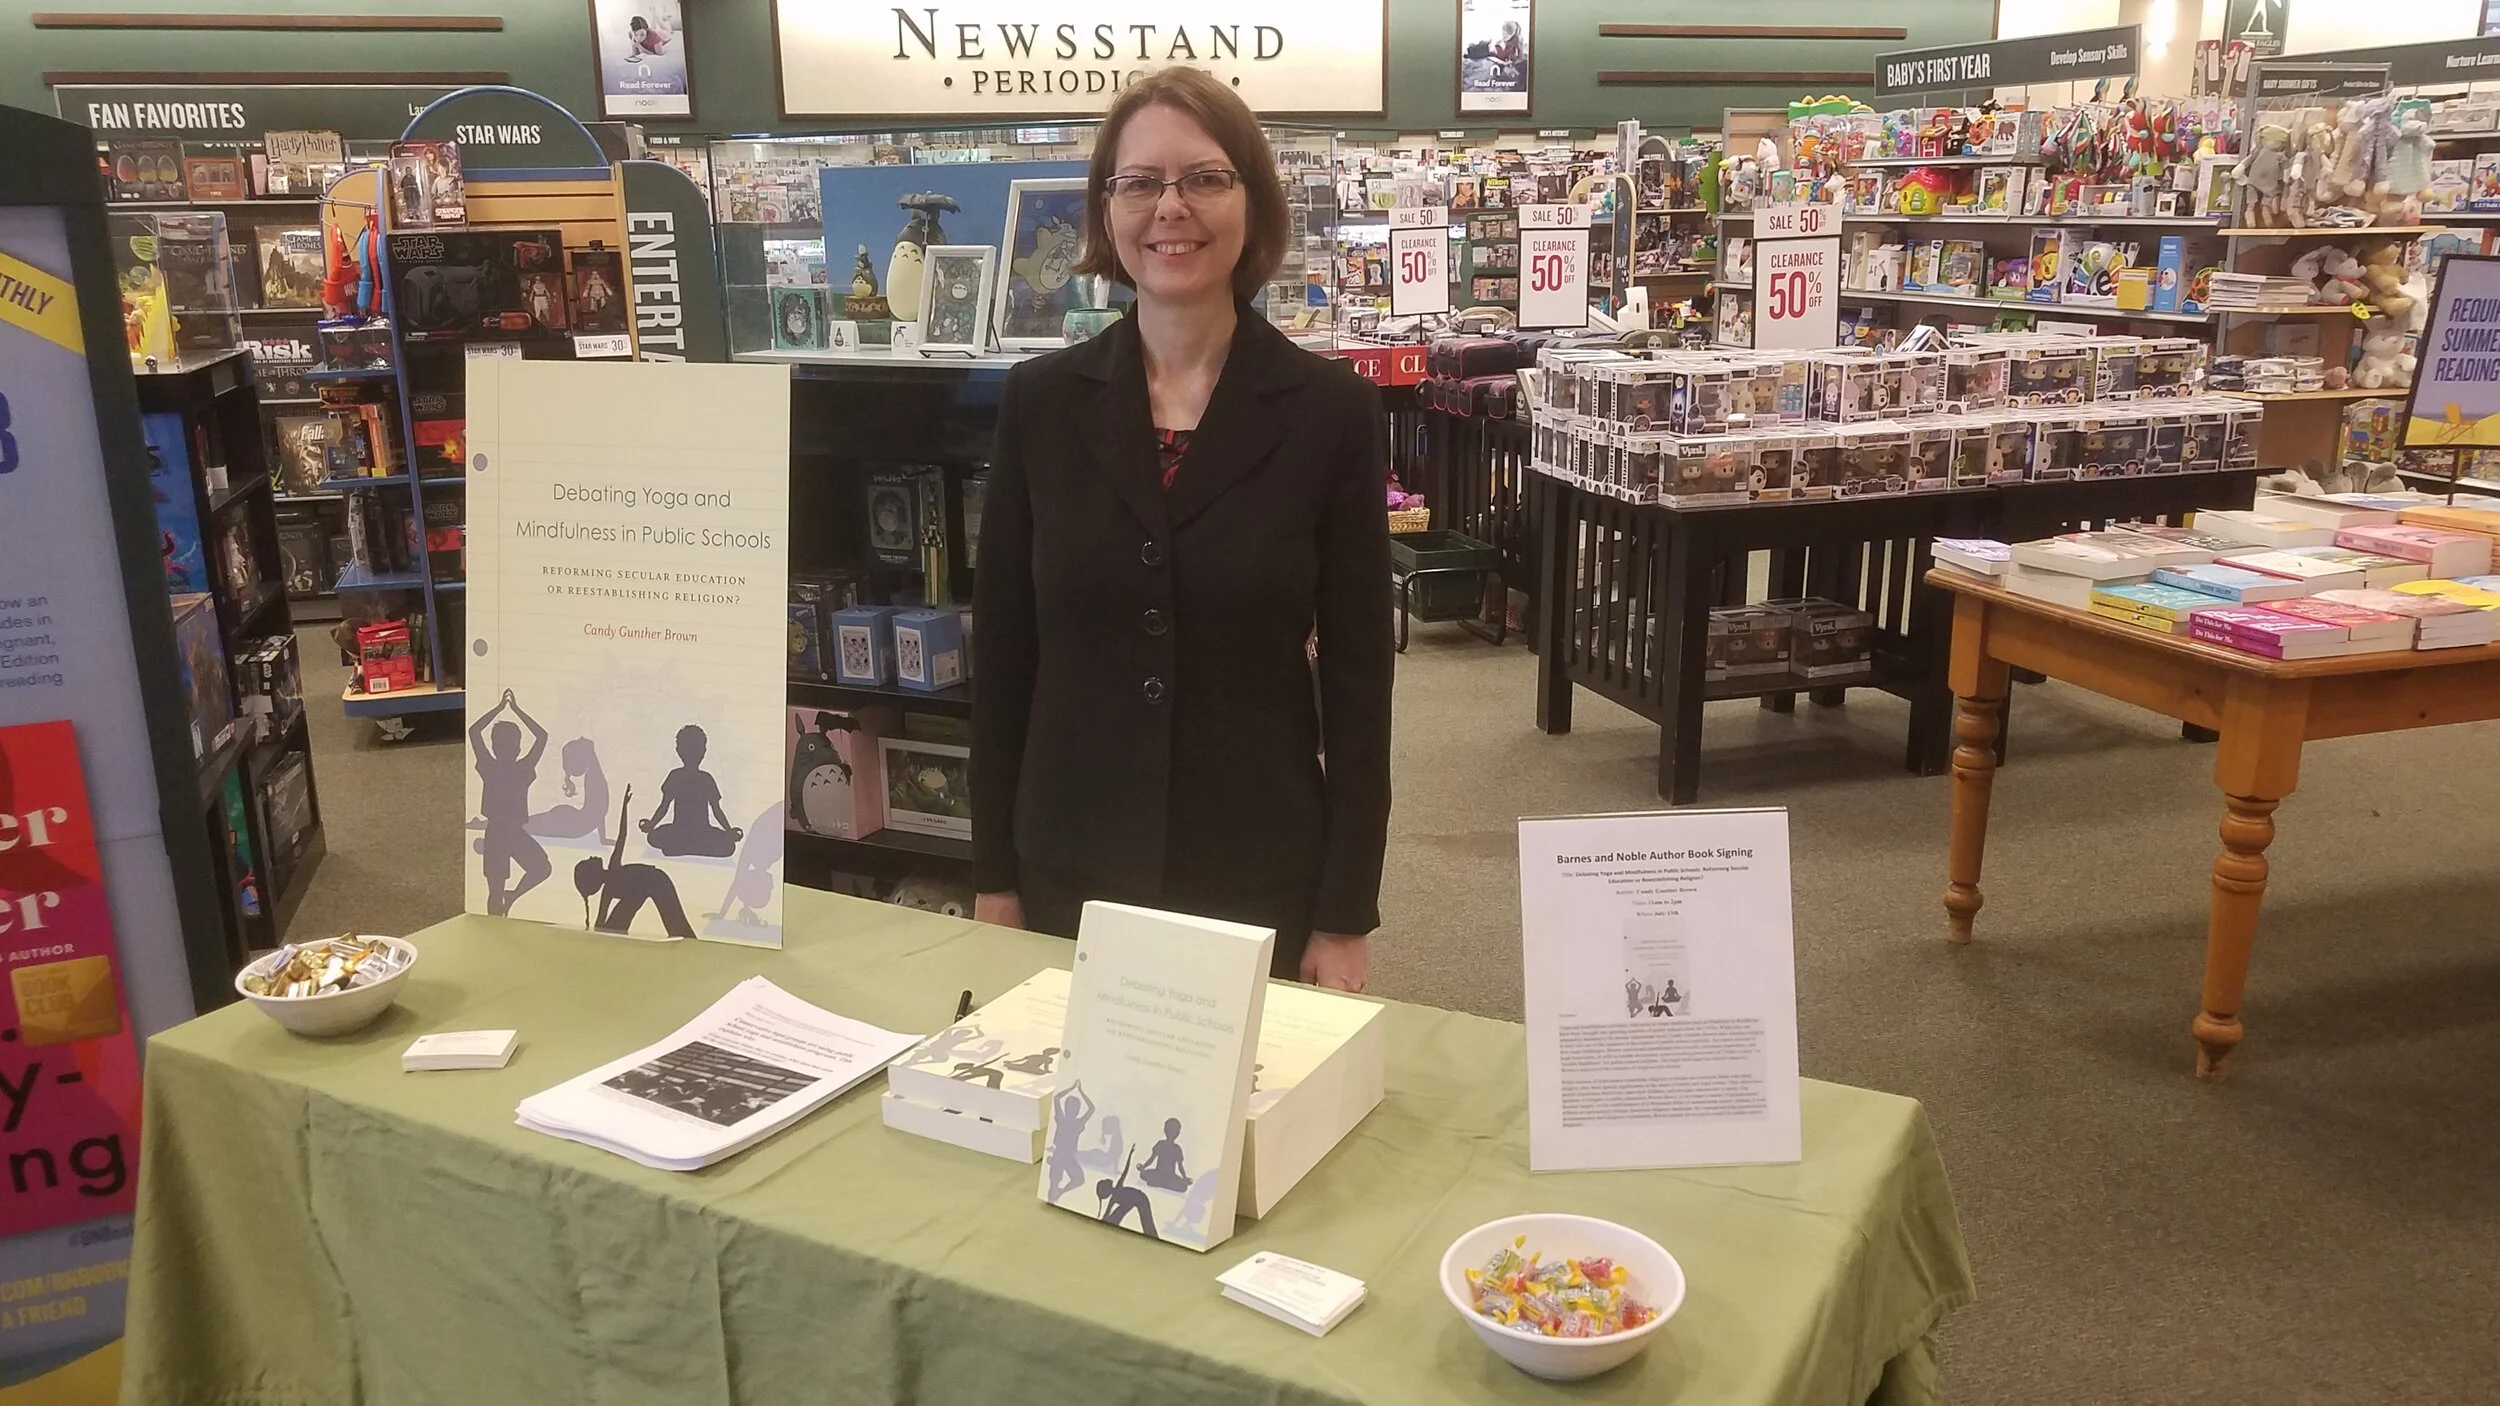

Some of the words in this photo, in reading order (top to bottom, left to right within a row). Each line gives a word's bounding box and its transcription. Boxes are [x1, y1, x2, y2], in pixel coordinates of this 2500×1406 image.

[892, 7, 1284, 60] NEWSSTAND
[2050, 50, 2077, 66] Develop
[2077, 48, 2106, 64] Sensory
[2106, 44, 2128, 61] Skills
[1887, 62, 1925, 87] BABY'S
[1926, 56, 1959, 84] FIRST
[1960, 53, 1991, 79] YEAR
[619, 81, 640, 89] Read
[641, 81, 673, 89] Forever
[1474, 79, 1491, 87] Read
[1491, 79, 1517, 87] Forever
[88, 103, 131, 129] FAN
[133, 103, 246, 129] FAVORITES
[408, 102, 426, 117] Lar
[456, 125, 495, 145] STAR
[497, 124, 542, 145] WARS
[270, 136, 302, 157] Harry
[302, 134, 337, 159] Potter
[1486, 178, 1509, 187] Nikon
[1399, 212, 1416, 224] SALE
[1532, 210, 1552, 222] SALE
[1769, 214, 1793, 230] SALE
[392, 236, 444, 249] STAR
[1401, 238, 1437, 250] CLEARANCE
[1532, 240, 1577, 252] CLEARANCE
[393, 247, 445, 260] WARS
[1770, 251, 1824, 268] CLEARANCE
[1564, 275, 1575, 284] OFF
[0, 273, 55, 315] THLY
[1808, 296, 1823, 308] OFF
[579, 342, 592, 350] STAR
[2442, 328, 2500, 352] SUMME
[467, 347, 482, 355] STAR
[481, 346, 498, 354] WARS
[1400, 354, 1426, 374] CL
[2434, 358, 2500, 382] READING
[553, 483, 636, 507] Debating
[642, 488, 689, 509] Yoga
[694, 490, 731, 508] and
[516, 521, 617, 542] Mindfulness
[622, 524, 637, 543] in
[643, 526, 696, 546] Public
[701, 529, 771, 550] Schools
[542, 566, 613, 579] REFORMING
[617, 570, 671, 582] SECULAR
[676, 573, 747, 586] EDUCATION
[547, 585, 563, 595] OR
[568, 586, 670, 601] REESTABLISHING
[675, 592, 741, 605] RELIGION?
[584, 623, 617, 639] Candy
[618, 626, 661, 641] Gunther
[664, 629, 698, 643] Brown
[0, 634, 56, 652] gnant,
[1, 655, 59, 668] Edition
[1557, 854, 1592, 865] Barnes
[1594, 853, 1614, 863] and
[1616, 852, 1647, 862] Noble
[1650, 850, 1685, 861] Author
[1688, 849, 1714, 859] Book
[1716, 847, 1754, 859] Signing
[8, 943, 75, 961] AUTHOR
[1120, 976, 1166, 998] Debating
[1167, 986, 1194, 1004] Yoga
[1194, 995, 1217, 1009] and
[1097, 991, 1150, 1014] Mindfulness
[1151, 1001, 1163, 1015] in
[1164, 1004, 1193, 1025] Public
[1195, 1014, 1235, 1035] Schools
